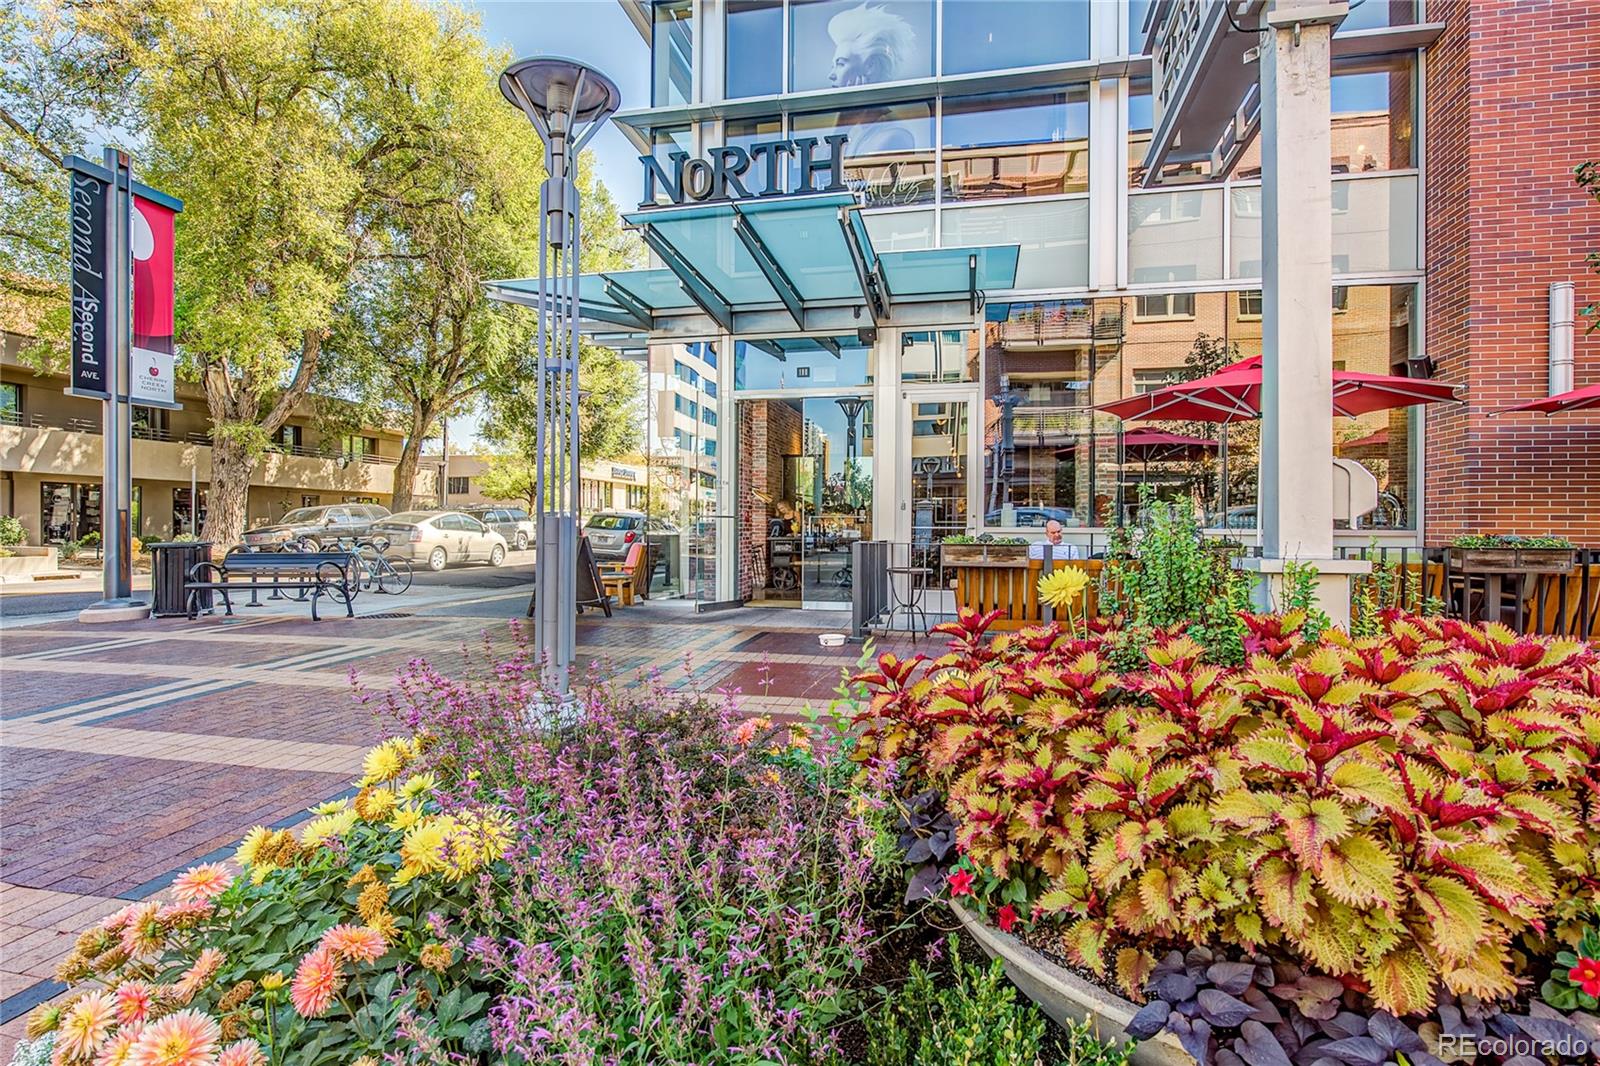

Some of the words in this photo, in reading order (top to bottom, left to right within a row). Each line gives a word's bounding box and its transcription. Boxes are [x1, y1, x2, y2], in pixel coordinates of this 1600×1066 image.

[74, 176, 103, 280] Second
[82, 300, 98, 366] Second
[81, 370, 100, 380] AVE.
[139, 374, 168, 384] CHERRY
[141, 380, 166, 389] CREEK
[141, 385, 167, 393] NORTH
